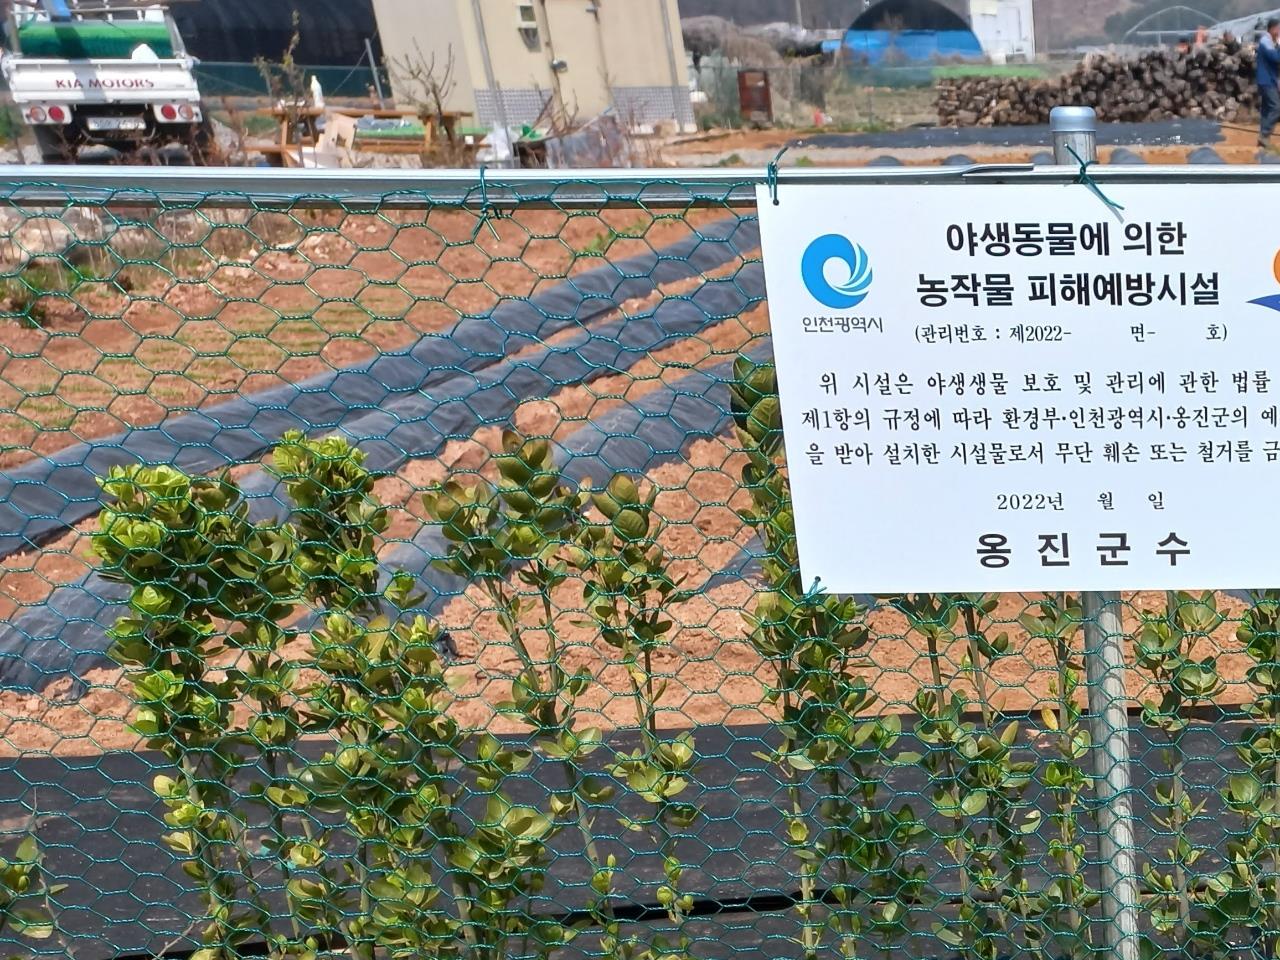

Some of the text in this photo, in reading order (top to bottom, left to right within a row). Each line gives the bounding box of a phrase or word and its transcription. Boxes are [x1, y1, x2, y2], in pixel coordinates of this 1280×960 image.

[55, 78, 155, 88] KIA MOTORS
[946, 221, 1188, 258] 야생동물에 의한
[916, 271, 1220, 308] 농작물 피해예방시설
[802, 315, 884, 334] 인천광역시
[914, 323, 988, 345] (관리번호
[1009, 323, 1073, 345] 제2022-
[1129, 322, 1156, 343] 면-
[1205, 323, 1228, 342] 호)
[819, 371, 838, 397] 위
[852, 371, 914, 397] 시설은
[926, 371, 1009, 397] 야생생물
[1021, 372, 1062, 392] 보호
[1073, 370, 1092, 396] 및
[1105, 370, 1165, 395] 관리에
[1178, 370, 1220, 394] 관한
[1231, 369, 1272, 394] 법률
[801, 407, 871, 432] 제1항의
[882, 407, 941, 432] 규정에
[951, 407, 993, 431] 따라
[805, 442, 825, 466] 을
[833, 442, 874, 466] 받아
[882, 442, 941, 466] 설치한
[949, 441, 1044, 466] 시설물로서
[1054, 441, 1094, 465] 무단
[1102, 440, 1141, 464] 훼손
[1149, 441, 1188, 463] 또는
[1197, 439, 1254, 463] 철거를
[996, 490, 1165, 511] 2022년 월 일
